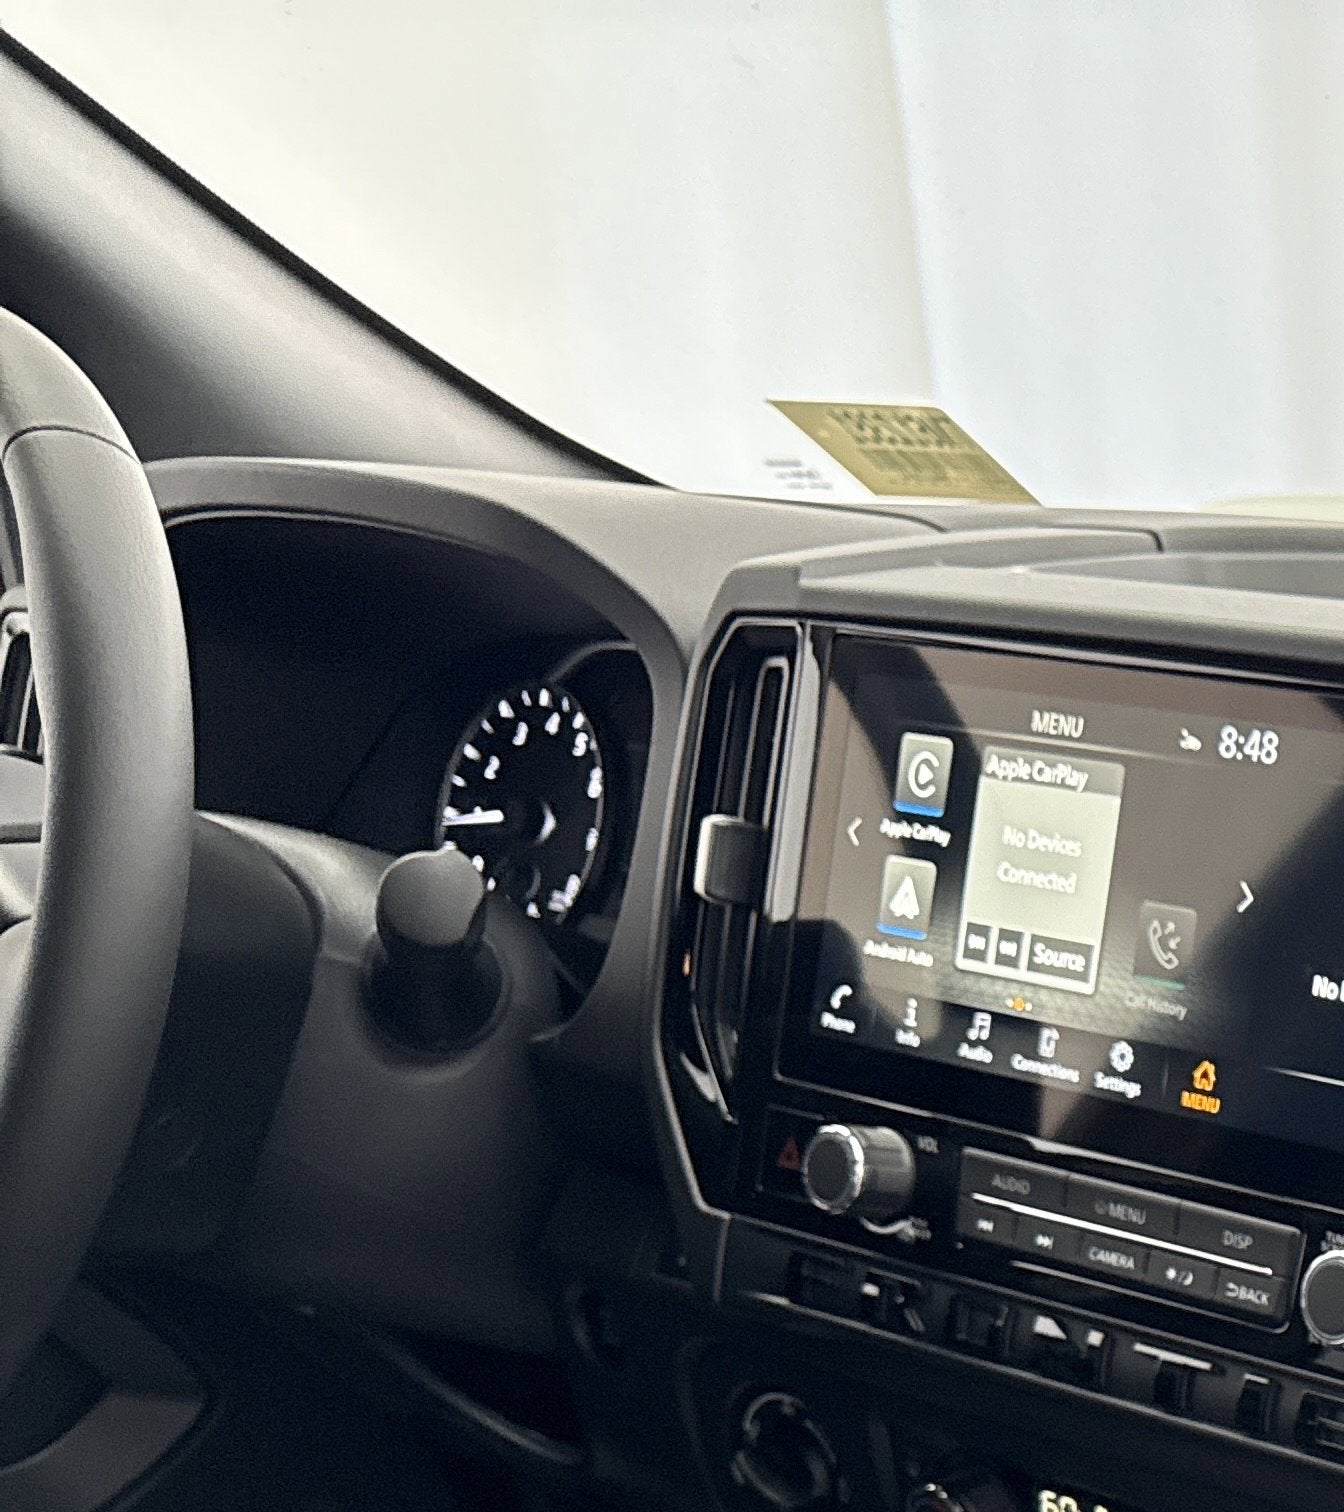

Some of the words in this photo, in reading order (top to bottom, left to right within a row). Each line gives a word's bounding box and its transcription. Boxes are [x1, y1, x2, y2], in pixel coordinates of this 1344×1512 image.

[1031, 710, 1084, 738] MENU
[1218, 725, 1279, 765] 8:48
[985, 754, 1028, 782] Apple
[1031, 757, 1088, 792] CarPlay
[880, 818, 912, 840] Apple
[912, 823, 951, 847] CarPlay
[1003, 826, 1026, 849] No
[1027, 829, 1082, 858] Devices
[997, 861, 1077, 894] Connected
[1033, 943, 1086, 972] Source
[1312, 975, 1338, 1001] No
[1147, 997, 1188, 1021] History
[1094, 1071, 1142, 1099] Settings
[1180, 1091, 1221, 1114] MENU
[991, 1173, 1031, 1196] AUDIO
[1108, 1202, 1147, 1226] MENU
[1222, 1230, 1253, 1250] DISP
[1088, 1246, 1136, 1271] CAMERA
[1238, 1285, 1270, 1306] BACK
